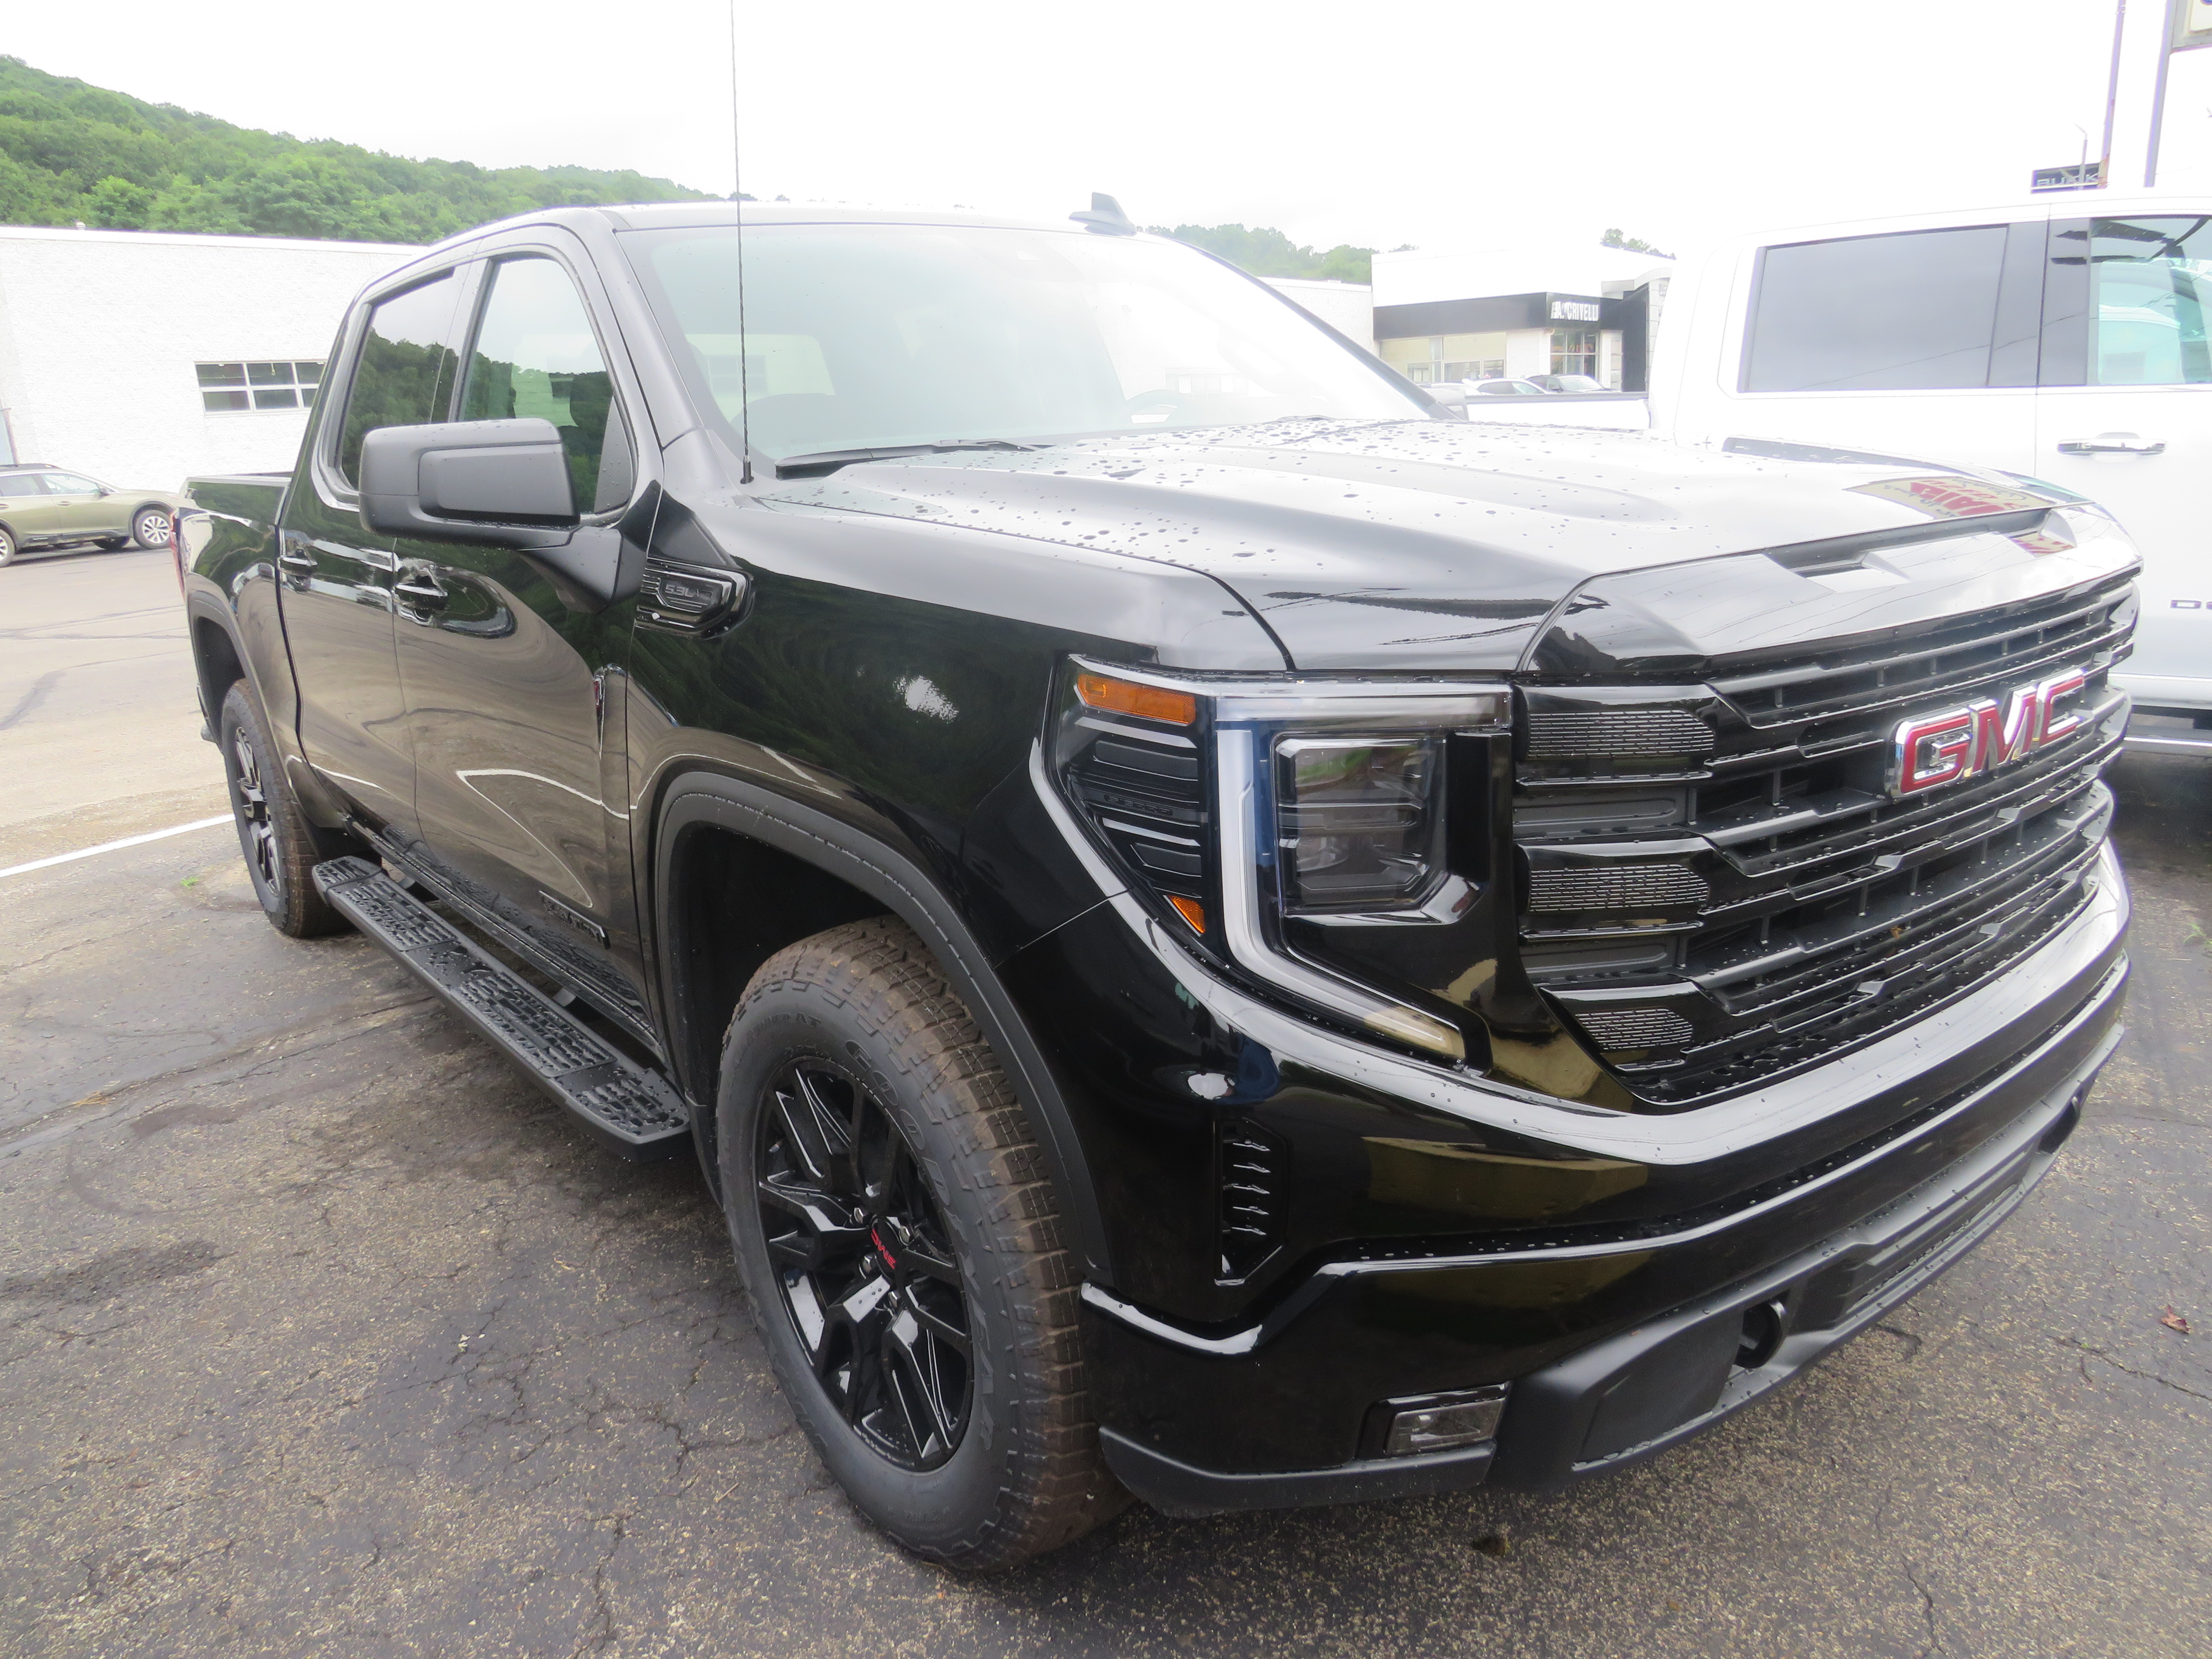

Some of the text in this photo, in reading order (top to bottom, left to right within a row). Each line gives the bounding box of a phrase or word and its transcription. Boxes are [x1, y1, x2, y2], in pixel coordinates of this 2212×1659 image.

[1565, 302, 1598, 321] CRIVELLI
[2170, 600, 2212, 609] D
[1895, 668, 2085, 797] GMC
[870, 1227, 896, 1269] GMC
